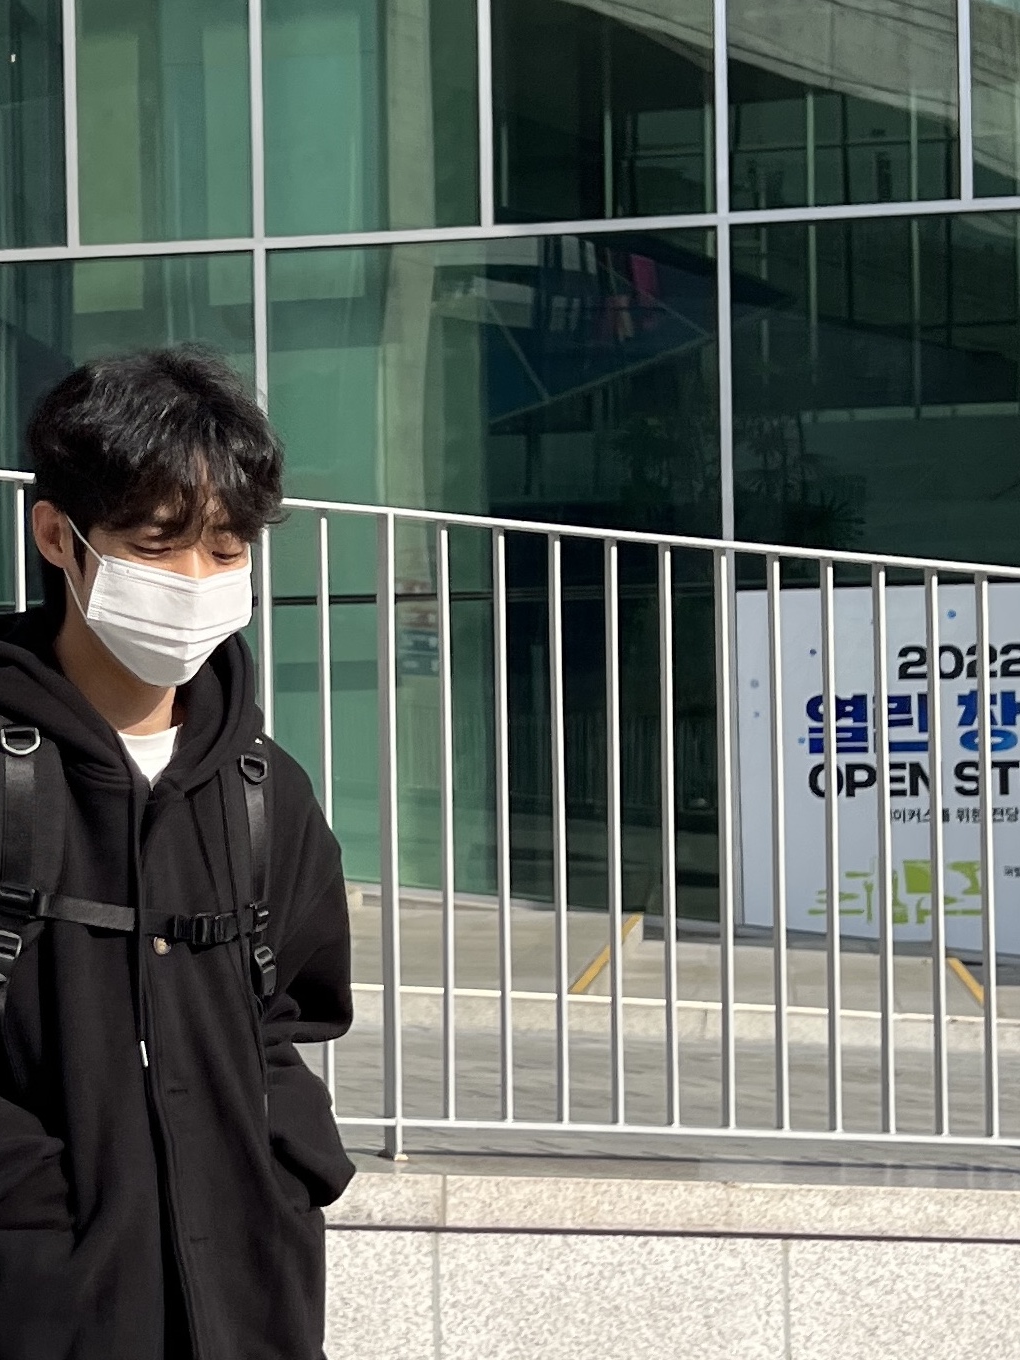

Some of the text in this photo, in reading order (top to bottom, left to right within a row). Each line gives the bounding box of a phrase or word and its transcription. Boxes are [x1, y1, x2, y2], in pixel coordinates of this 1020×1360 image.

[897, 642, 1020, 680] 2022
[806, 692, 930, 754] 열린
[808, 761, 941, 798] OPEN
